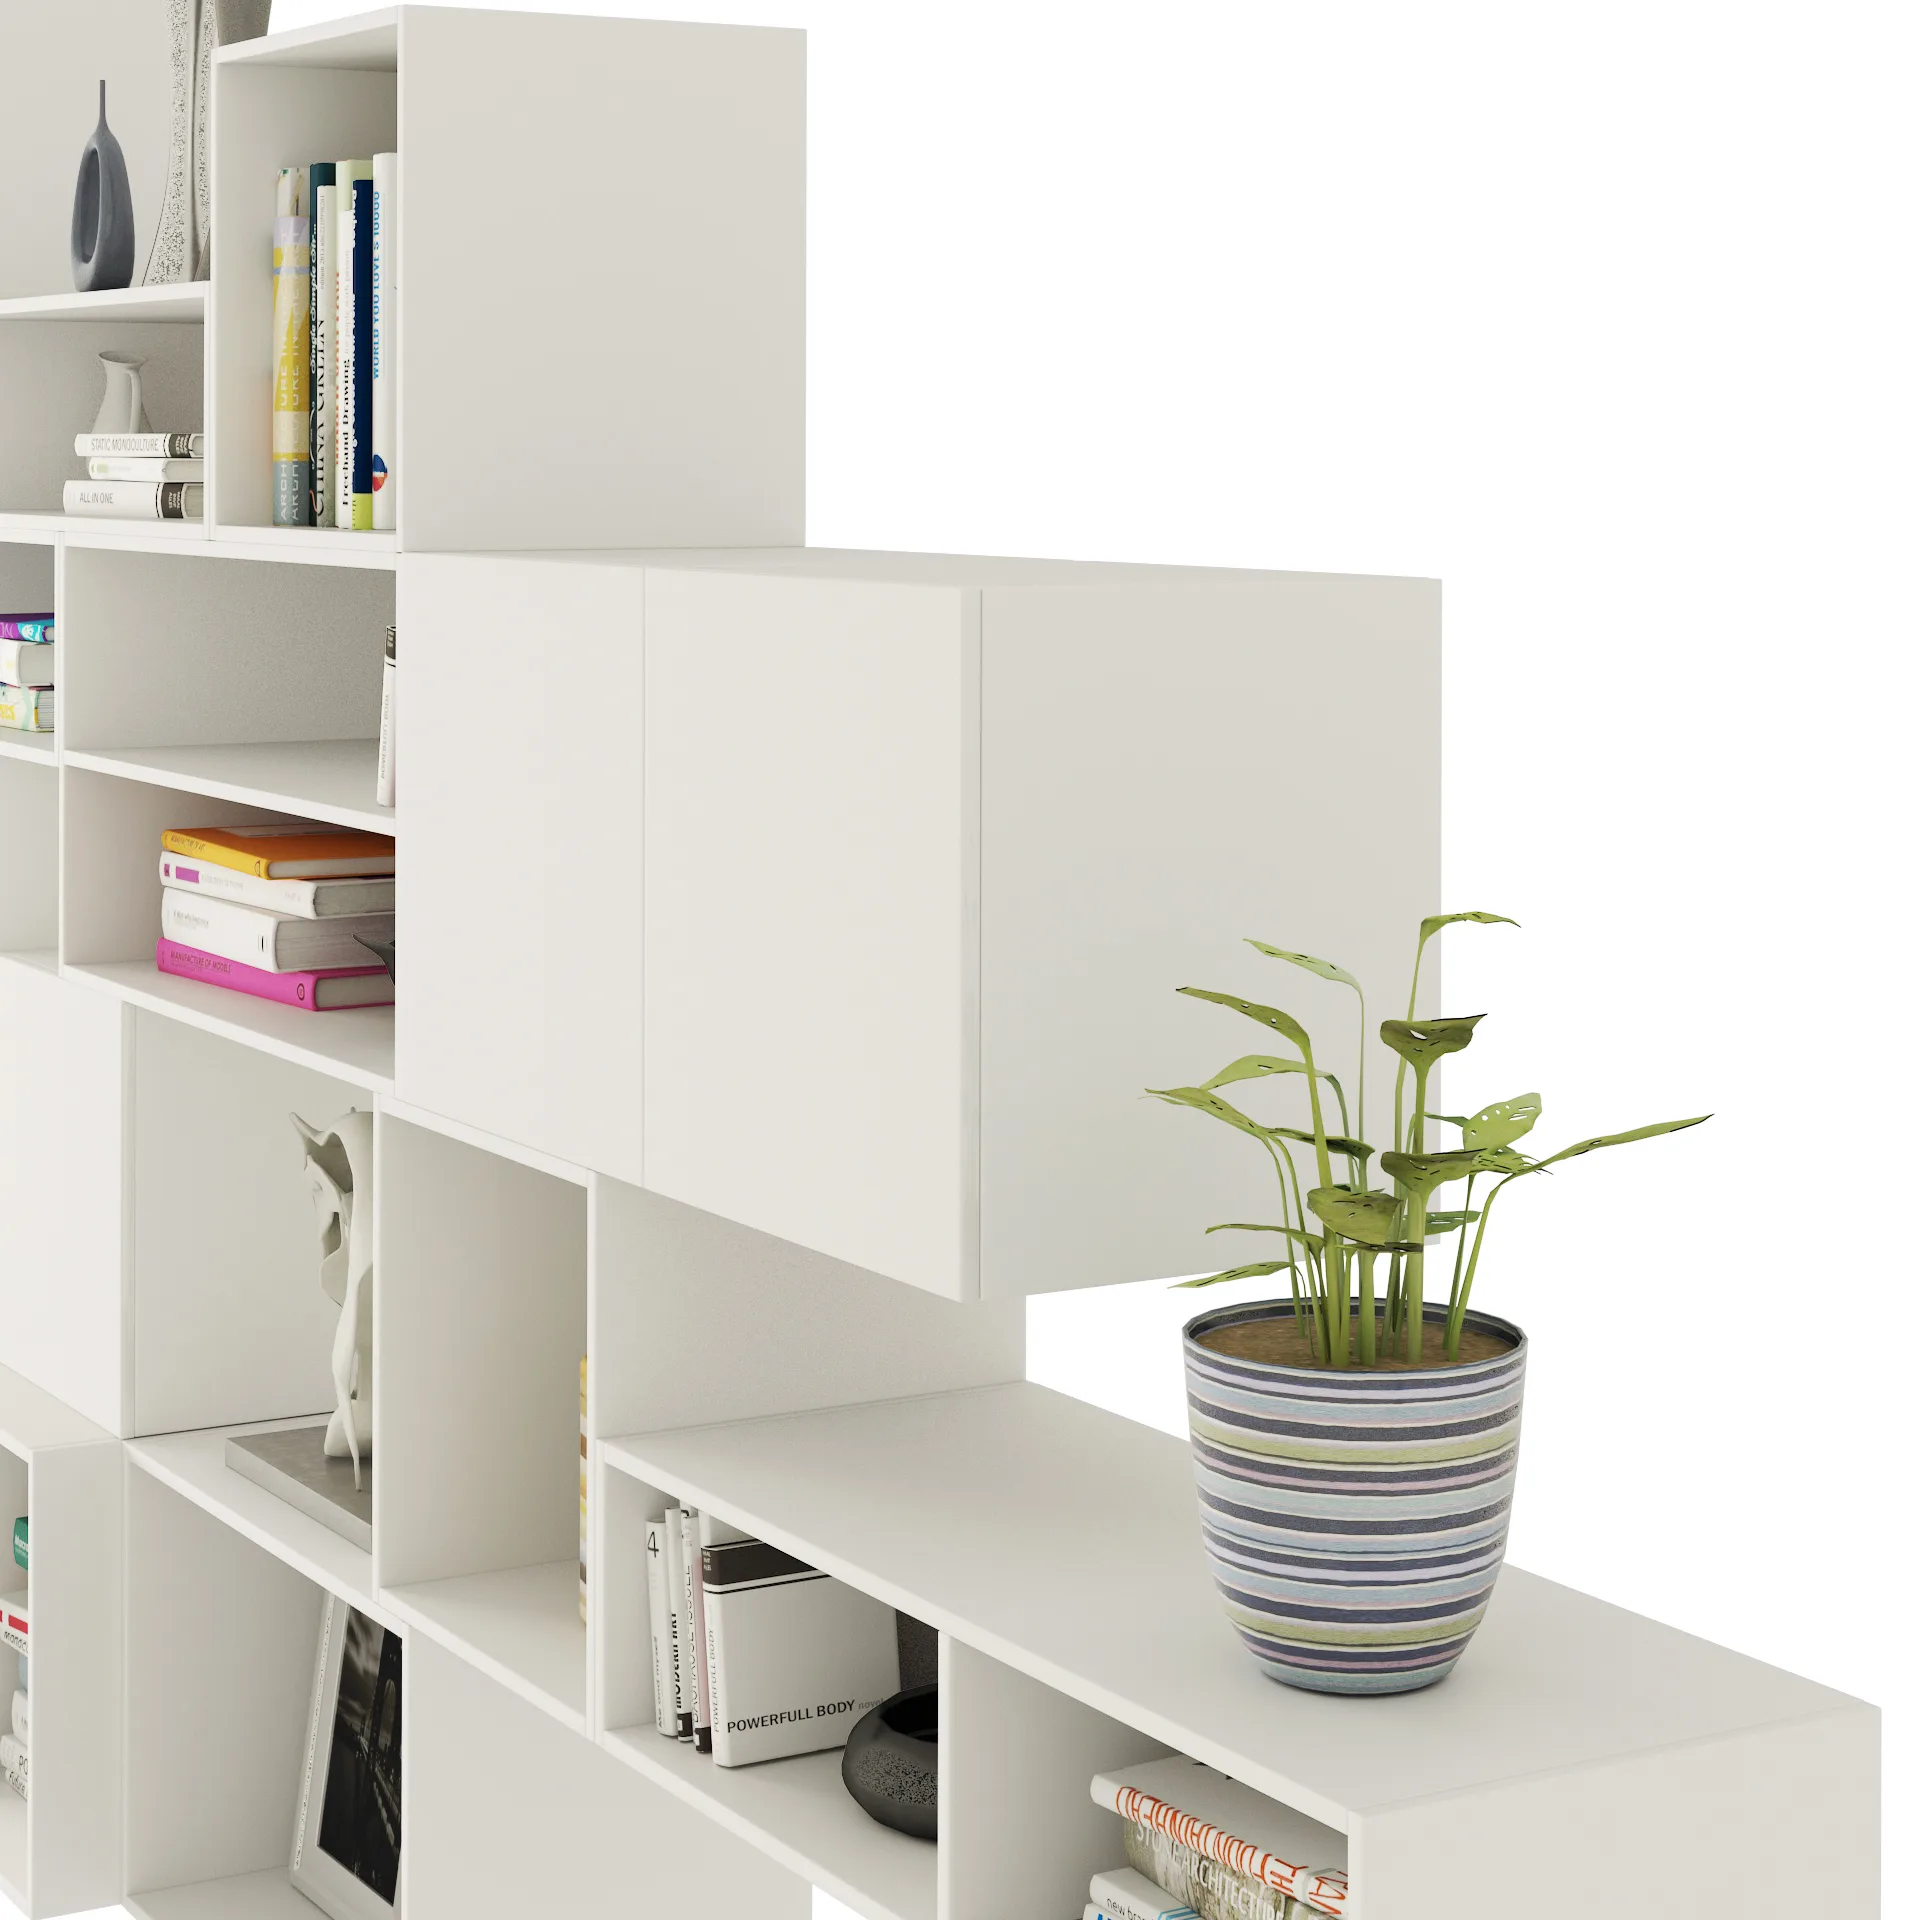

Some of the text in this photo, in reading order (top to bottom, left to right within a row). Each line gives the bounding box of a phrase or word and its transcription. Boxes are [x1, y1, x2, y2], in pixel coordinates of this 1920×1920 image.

[91, 438, 159, 451] STATIC MONOCULTURE
[80, 492, 114, 504] ALL IN ONE
[647, 1531, 659, 1558] 4
[727, 1707, 813, 1733] POWERFULL
[816, 1699, 856, 1717] BODY
[1106, 1898, 1126, 1916] new
